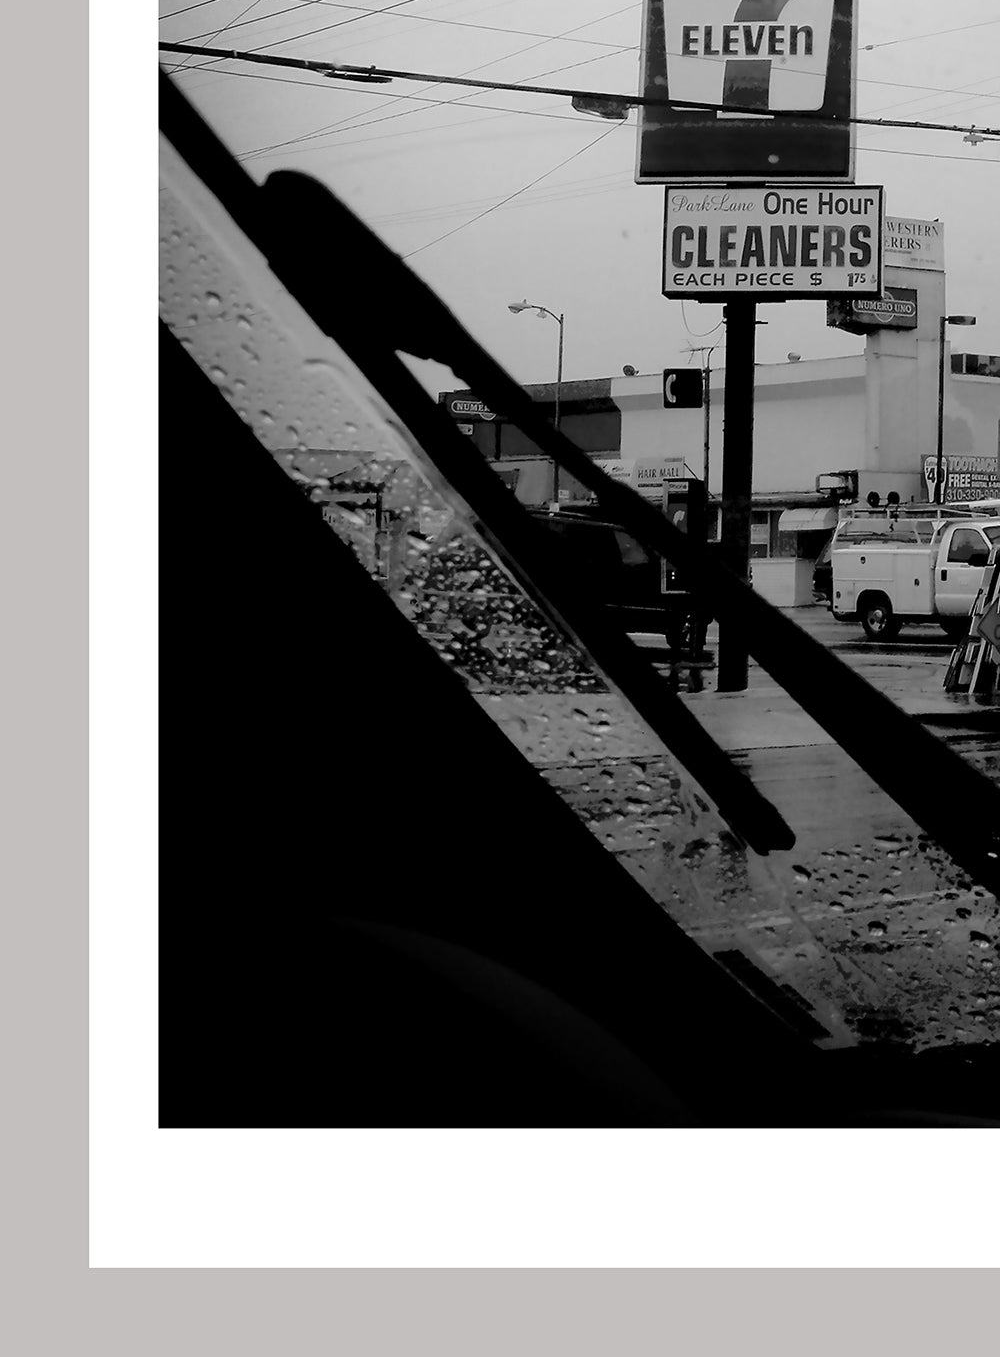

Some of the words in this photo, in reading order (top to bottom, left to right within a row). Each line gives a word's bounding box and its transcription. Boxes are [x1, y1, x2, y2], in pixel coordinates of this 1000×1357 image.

[671, 193, 711, 213] Park
[711, 193, 754, 212] Lane
[763, 191, 808, 215] One
[818, 192, 874, 215] Hour
[886, 221, 939, 237] WESTERN
[671, 224, 872, 268] CLEANERS
[673, 273, 725, 286] EACH
[735, 273, 794, 286] PIECE
[857, 299, 893, 312] NUMERO
[894, 302, 912, 314] UNO
[948, 456, 999, 473] TOOTHACH
[948, 473, 971, 488] FREE
